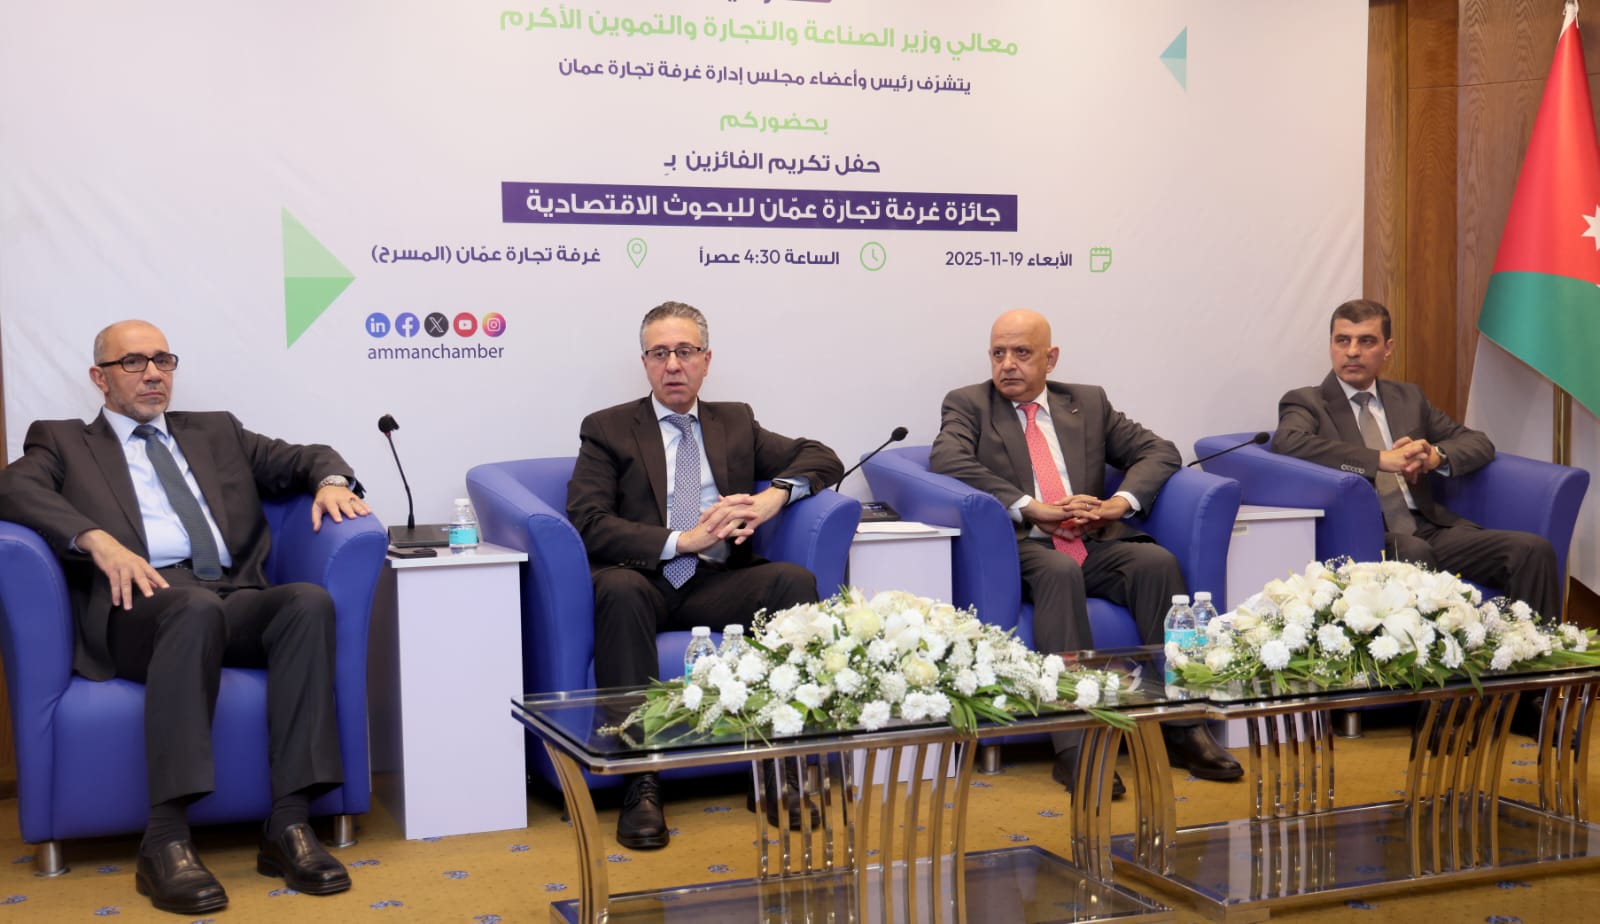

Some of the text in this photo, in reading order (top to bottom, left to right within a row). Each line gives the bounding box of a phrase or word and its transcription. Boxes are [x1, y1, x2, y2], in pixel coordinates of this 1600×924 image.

[500, 4, 1018, 61] معالي وزير الصناعة والتجارة والتموين الأكرم
[559, 58, 604, 76] عمان
[608, 60, 654, 80] تجارة
[658, 61, 701, 82] غرفة
[706, 65, 743, 85] إدارة
[747, 69, 805, 86] مجلس
[809, 69, 867, 90] وأعضاء
[871, 75, 913, 92] رئيس
[720, 112, 828, 134] بحضوركم
[686, 150, 763, 172] الفائزين
[768, 155, 830, 175] تكريم
[835, 154, 880, 176] حفل
[527, 189, 657, 217] الاقتصادية
[664, 194, 754, 220] للبحوث
[823, 199, 880, 223] تجارة
[886, 198, 939, 223] غرفة
[946, 202, 1000, 225] جائزة
[372, 245, 452, 264] (المسرح)
[506, 247, 552, 264] تجارة
[557, 247, 600, 265] غرفة
[744, 249, 780, 264] 4:30
[785, 249, 839, 264] الساعة
[1027, 251, 1072, 268] الأبعاء
[368, 343, 504, 359] ammanchamber
